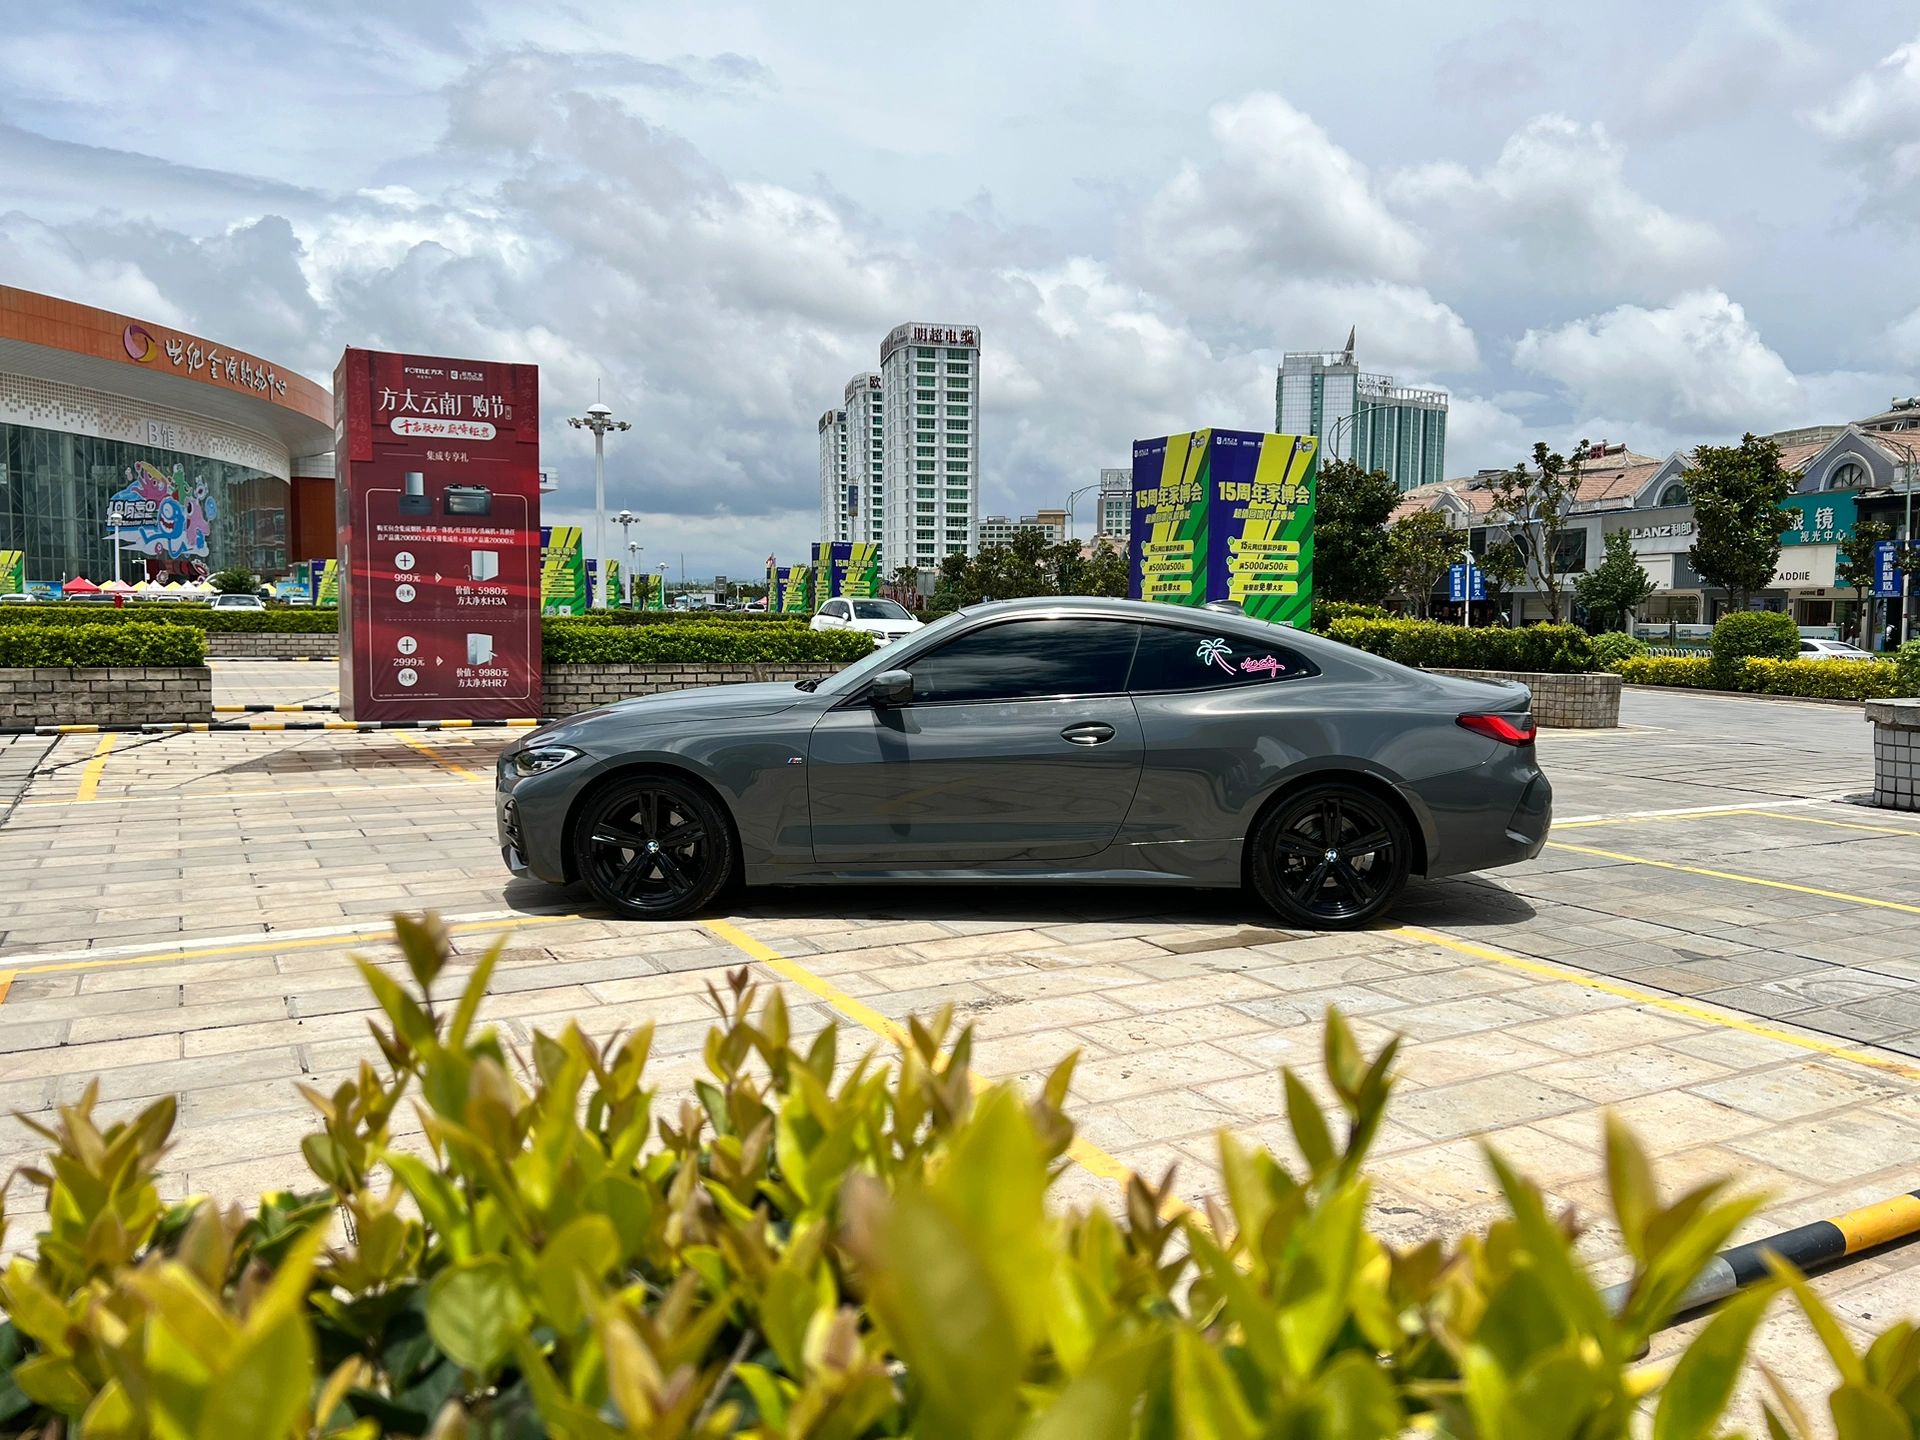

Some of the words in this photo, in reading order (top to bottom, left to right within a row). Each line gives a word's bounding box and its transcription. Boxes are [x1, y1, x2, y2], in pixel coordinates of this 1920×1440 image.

[914, 327, 974, 345] 明超电缆
[165, 338, 287, 400] 世纪金源购物中心
[378, 387, 504, 418] 方太云南厂购节
[426, 450, 469, 463] 集成专享礼
[1136, 483, 1203, 509] 15周年家博会
[1218, 481, 1310, 505] 15周年家博会
[1629, 525, 1671, 539] ILANZ
[1671, 522, 1693, 536] 利郎
[1800, 529, 1846, 543] 视光中心
[1239, 562, 1288, 571] 满5000减500元
[394, 572, 421, 583] 999元
[1778, 571, 1811, 581] ADDIIE
[457, 596, 507, 606] 方太净水H3A
[393, 657, 425, 667] 2999元
[458, 679, 508, 688] 方太净水HR7
